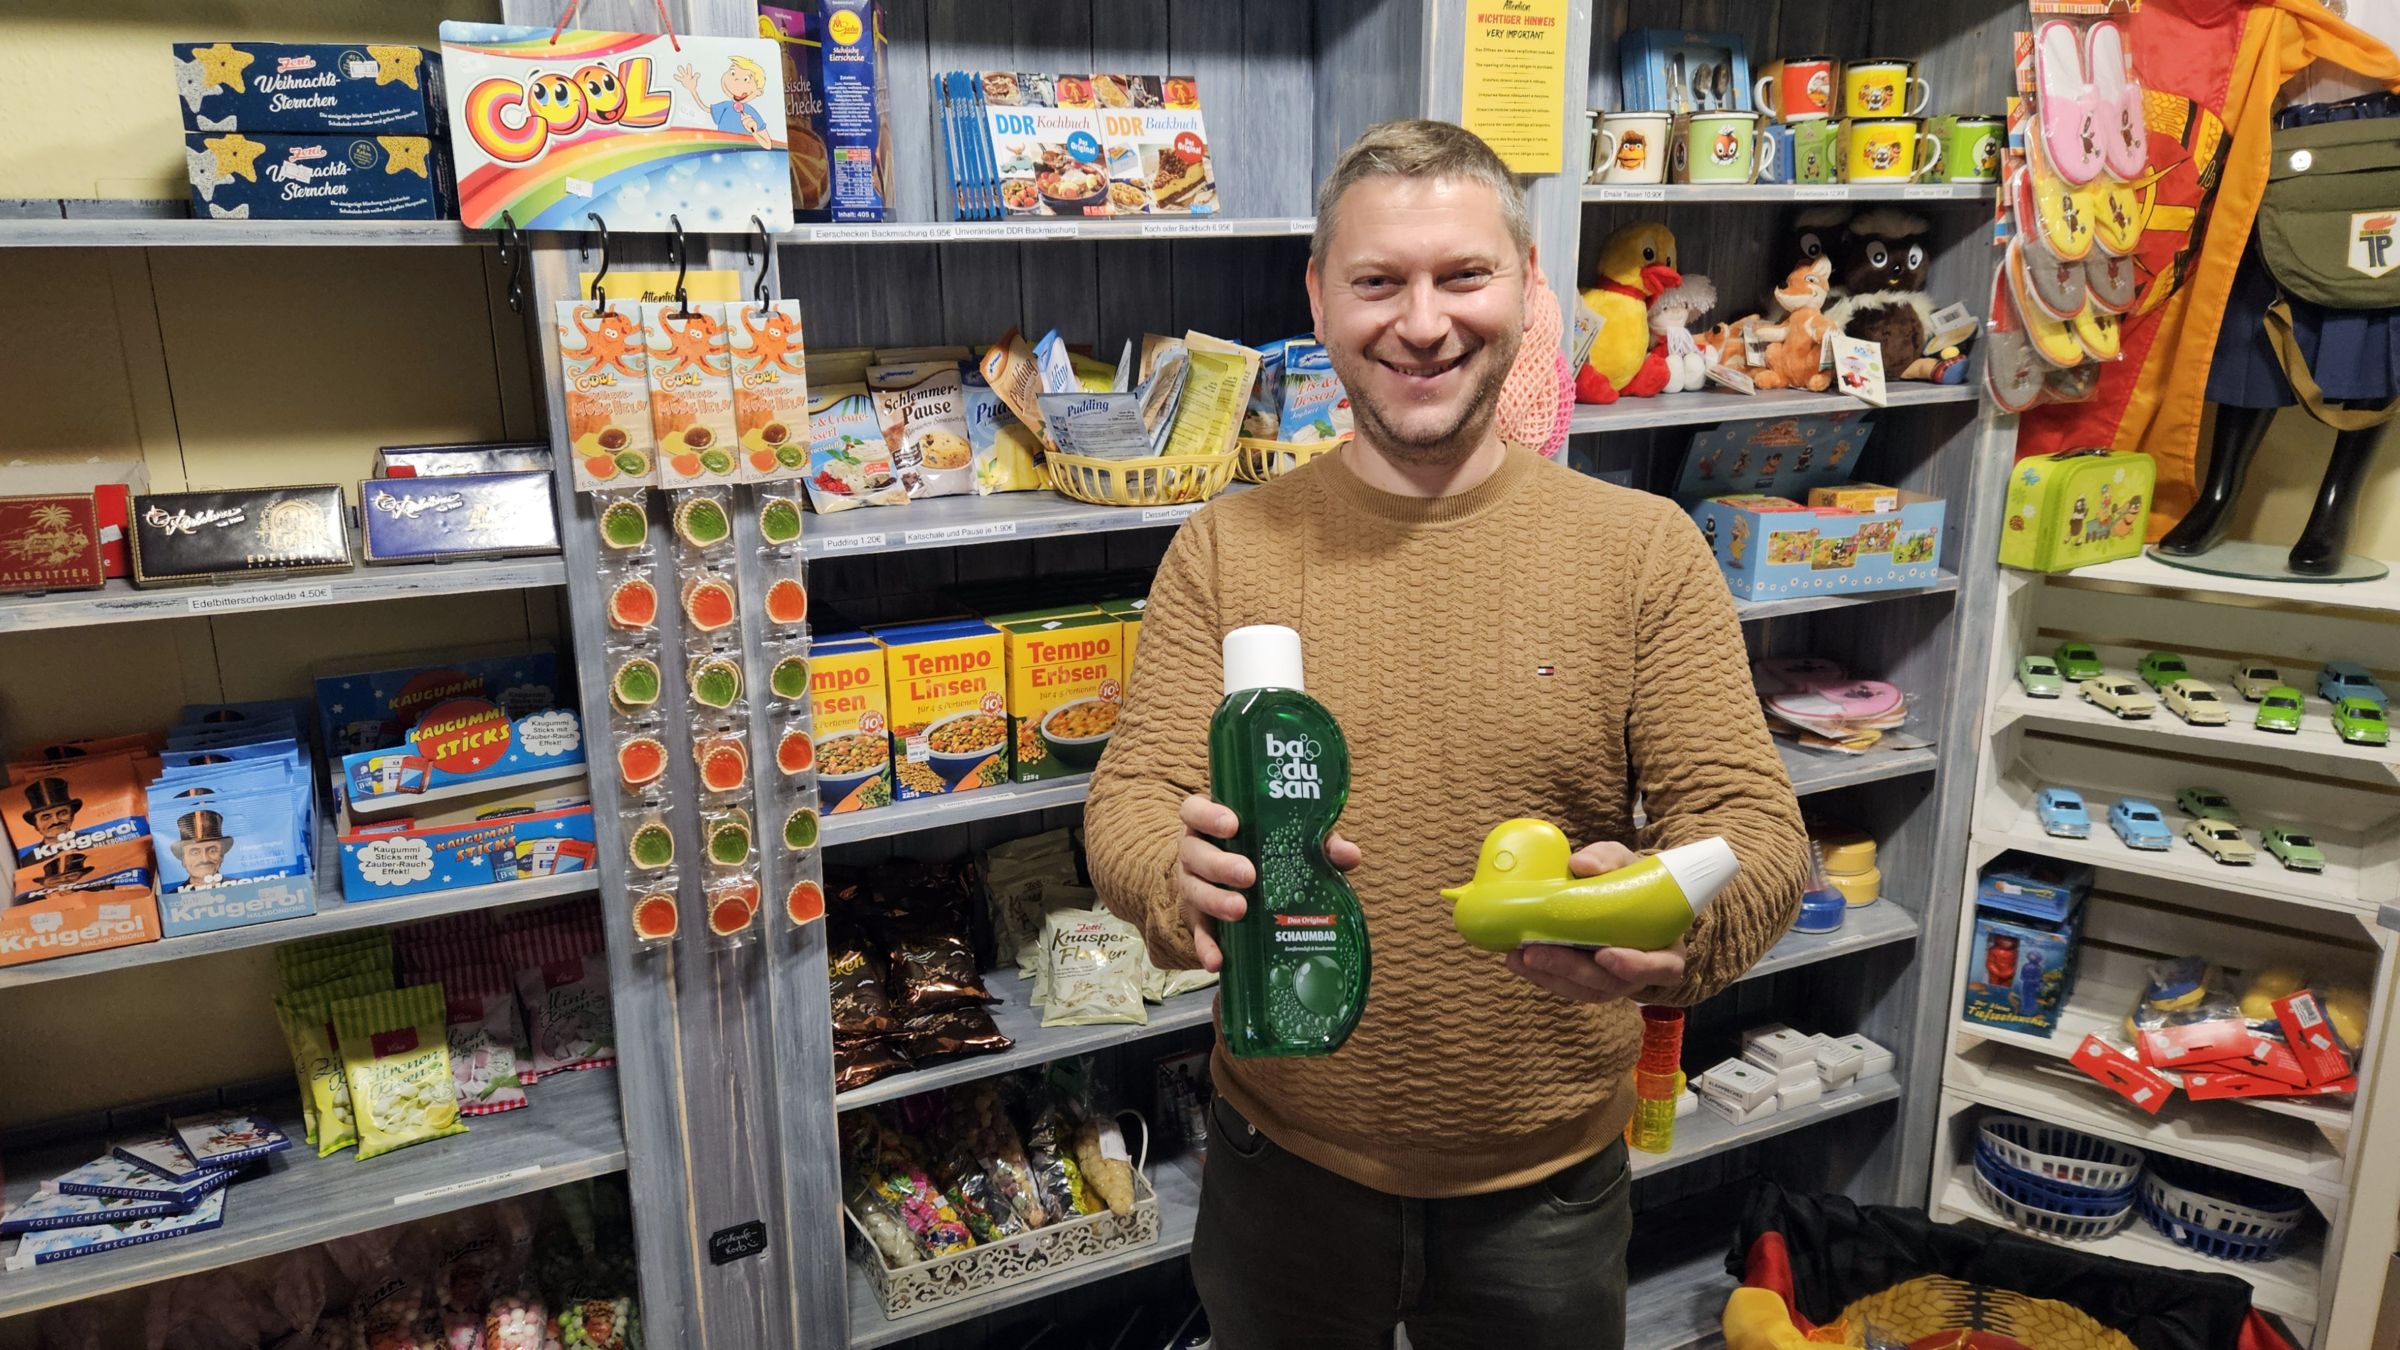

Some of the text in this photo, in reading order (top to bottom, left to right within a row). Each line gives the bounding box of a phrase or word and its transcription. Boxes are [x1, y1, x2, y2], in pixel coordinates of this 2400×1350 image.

[1503, 0, 1531, 11] Attention
[1478, 13, 1556, 27] WICHTIGER HINWEIS
[1486, 29, 1544, 40] VERY IMPORTANT
[829, 54, 865, 62] Eierschecke
[254, 71, 341, 94] Weihnachts-
[785, 76, 812, 93] sische
[269, 92, 338, 113] Sternchen
[464, 54, 675, 165] COOL
[786, 93, 823, 116] checke
[995, 114, 1090, 136] DDR Kochbuch
[1106, 116, 1198, 137] DDR Backbuch
[1070, 142, 1096, 156] Original
[1078, 137, 1089, 147] Das
[1177, 142, 1202, 156] Original
[1184, 137, 1195, 147] Das
[266, 161, 352, 184] Wnachts-
[281, 181, 349, 201] Sternchen
[1623, 190, 1643, 198] Tassen
[838, 211, 856, 219] Inhalt:
[816, 228, 951, 239] Eierschecken Backmischung 6.95€
[954, 225, 1077, 236] Unveränderte DDR Backmischung
[1144, 223, 1231, 233] Koch oder Backbuch 6.95€
[884, 383, 958, 416] Schlemmer-
[1066, 398, 1110, 417] Pudding
[1293, 388, 1337, 410] Dessert
[902, 400, 952, 425] Pause
[810, 427, 837, 442] ssert
[1145, 510, 1170, 520] Dessert
[827, 535, 882, 548] Pudding 1.20€
[908, 524, 1014, 542] Kaltschale und Pause je 1.90€
[2, 568, 91, 582] ALBBITTER
[192, 588, 328, 609] Edelbitterschokolade 4.50€
[1026, 637, 1111, 664] Tempo
[902, 649, 992, 677] Tempo
[811, 666, 871, 691] mpo
[1031, 663, 1108, 688] Erbsen
[388, 672, 486, 710] KAUGUMMI
[910, 676, 987, 701] Linsen
[1103, 685, 1116, 696] 10
[811, 694, 867, 716] nsen
[984, 698, 998, 709] 10
[410, 701, 507, 743] KAUGUMMI
[531, 719, 570, 728] Kaugummi
[557, 726, 568, 734] mit
[865, 718, 878, 728] 10
[435, 723, 511, 761] STICKS
[525, 732, 576, 741] Zauber-Rauch
[538, 739, 562, 747] Effekt!
[1266, 733, 1304, 758] ba
[1282, 758, 1319, 780] du
[1269, 779, 1321, 800] san
[33, 819, 138, 862] Krügerol
[93, 831, 141, 849] HALSBONBONS
[436, 823, 516, 852] KAUGUMMI
[373, 846, 421, 855] Kaugummi
[375, 853, 402, 861] Sticks
[456, 835, 518, 862] STICKS
[365, 860, 427, 869] Zauber-Rauch
[381, 867, 410, 876] Effekt!
[246, 904, 307, 920] HALSBONBONS
[1287, 916, 1329, 925] Das Original
[81, 931, 146, 949] HALSBONBONS
[1052, 928, 1129, 951] Knusper
[1275, 930, 1337, 942] SCHAUMBAD
[829, 956, 867, 978] cken
[216, 1147, 272, 1162] ROTSTERN
[62, 1183, 162, 1200] VOLLMILCHSCHOKOLADE
[457, 1179, 486, 1190] Kissen
[29, 1205, 164, 1228] VOLLMILCHSCHOKOLADE
[45, 1227, 190, 1262] VOLLMILCHSCHOKOLADE
